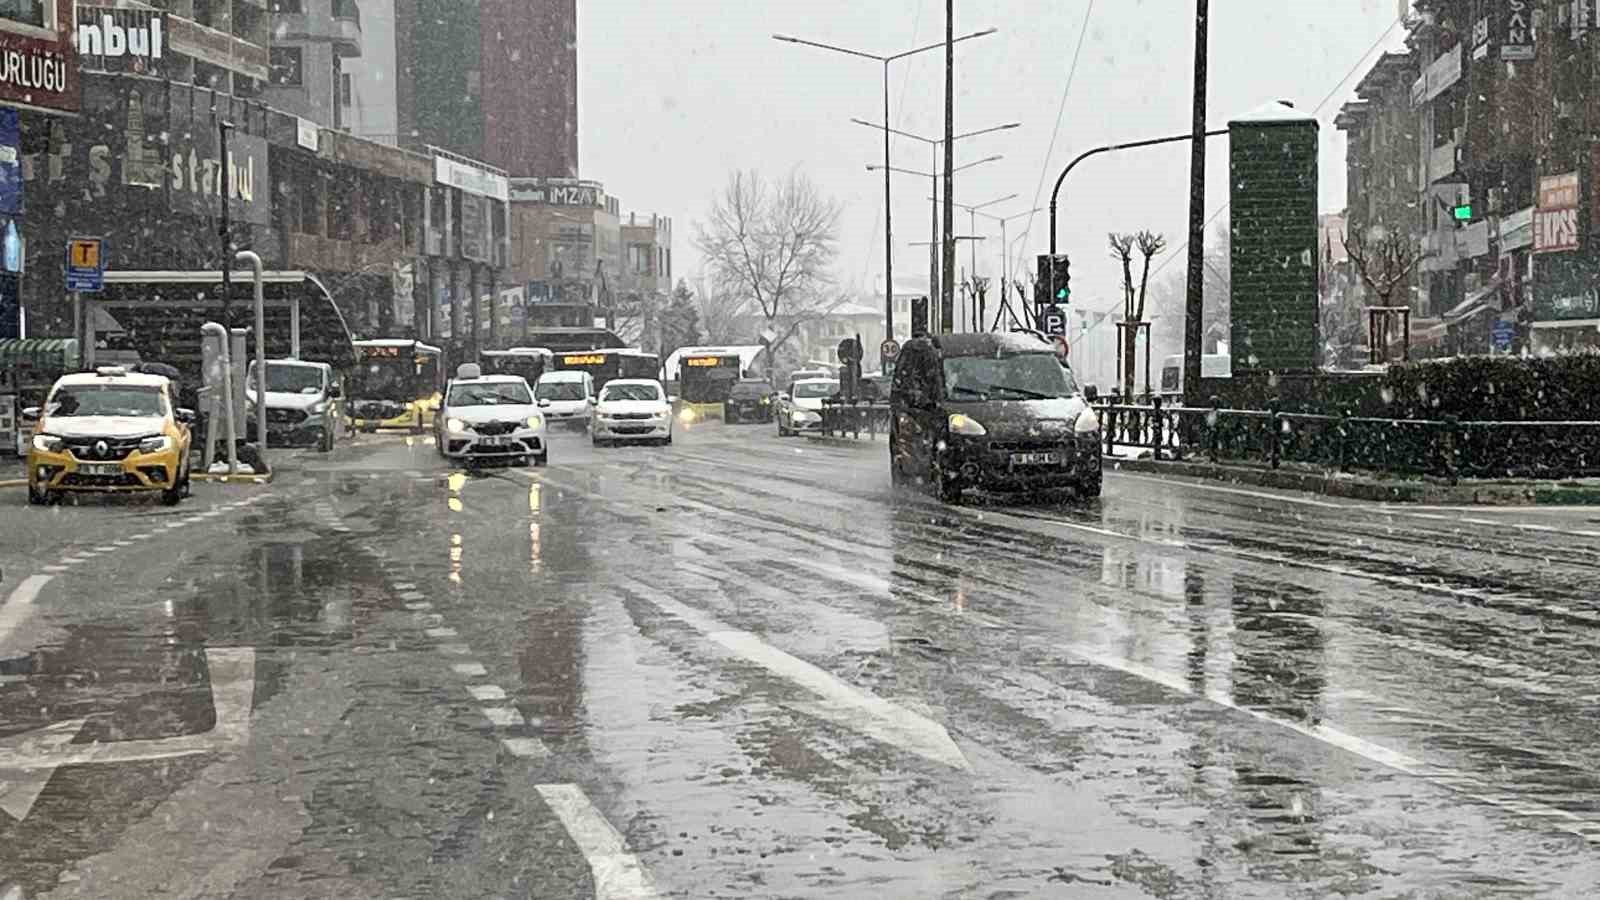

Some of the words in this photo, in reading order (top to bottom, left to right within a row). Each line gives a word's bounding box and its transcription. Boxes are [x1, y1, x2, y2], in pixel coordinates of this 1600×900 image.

[1543, 208, 1578, 248] KPSS
[79, 243, 93, 264] T
[1047, 315, 1062, 333] P
